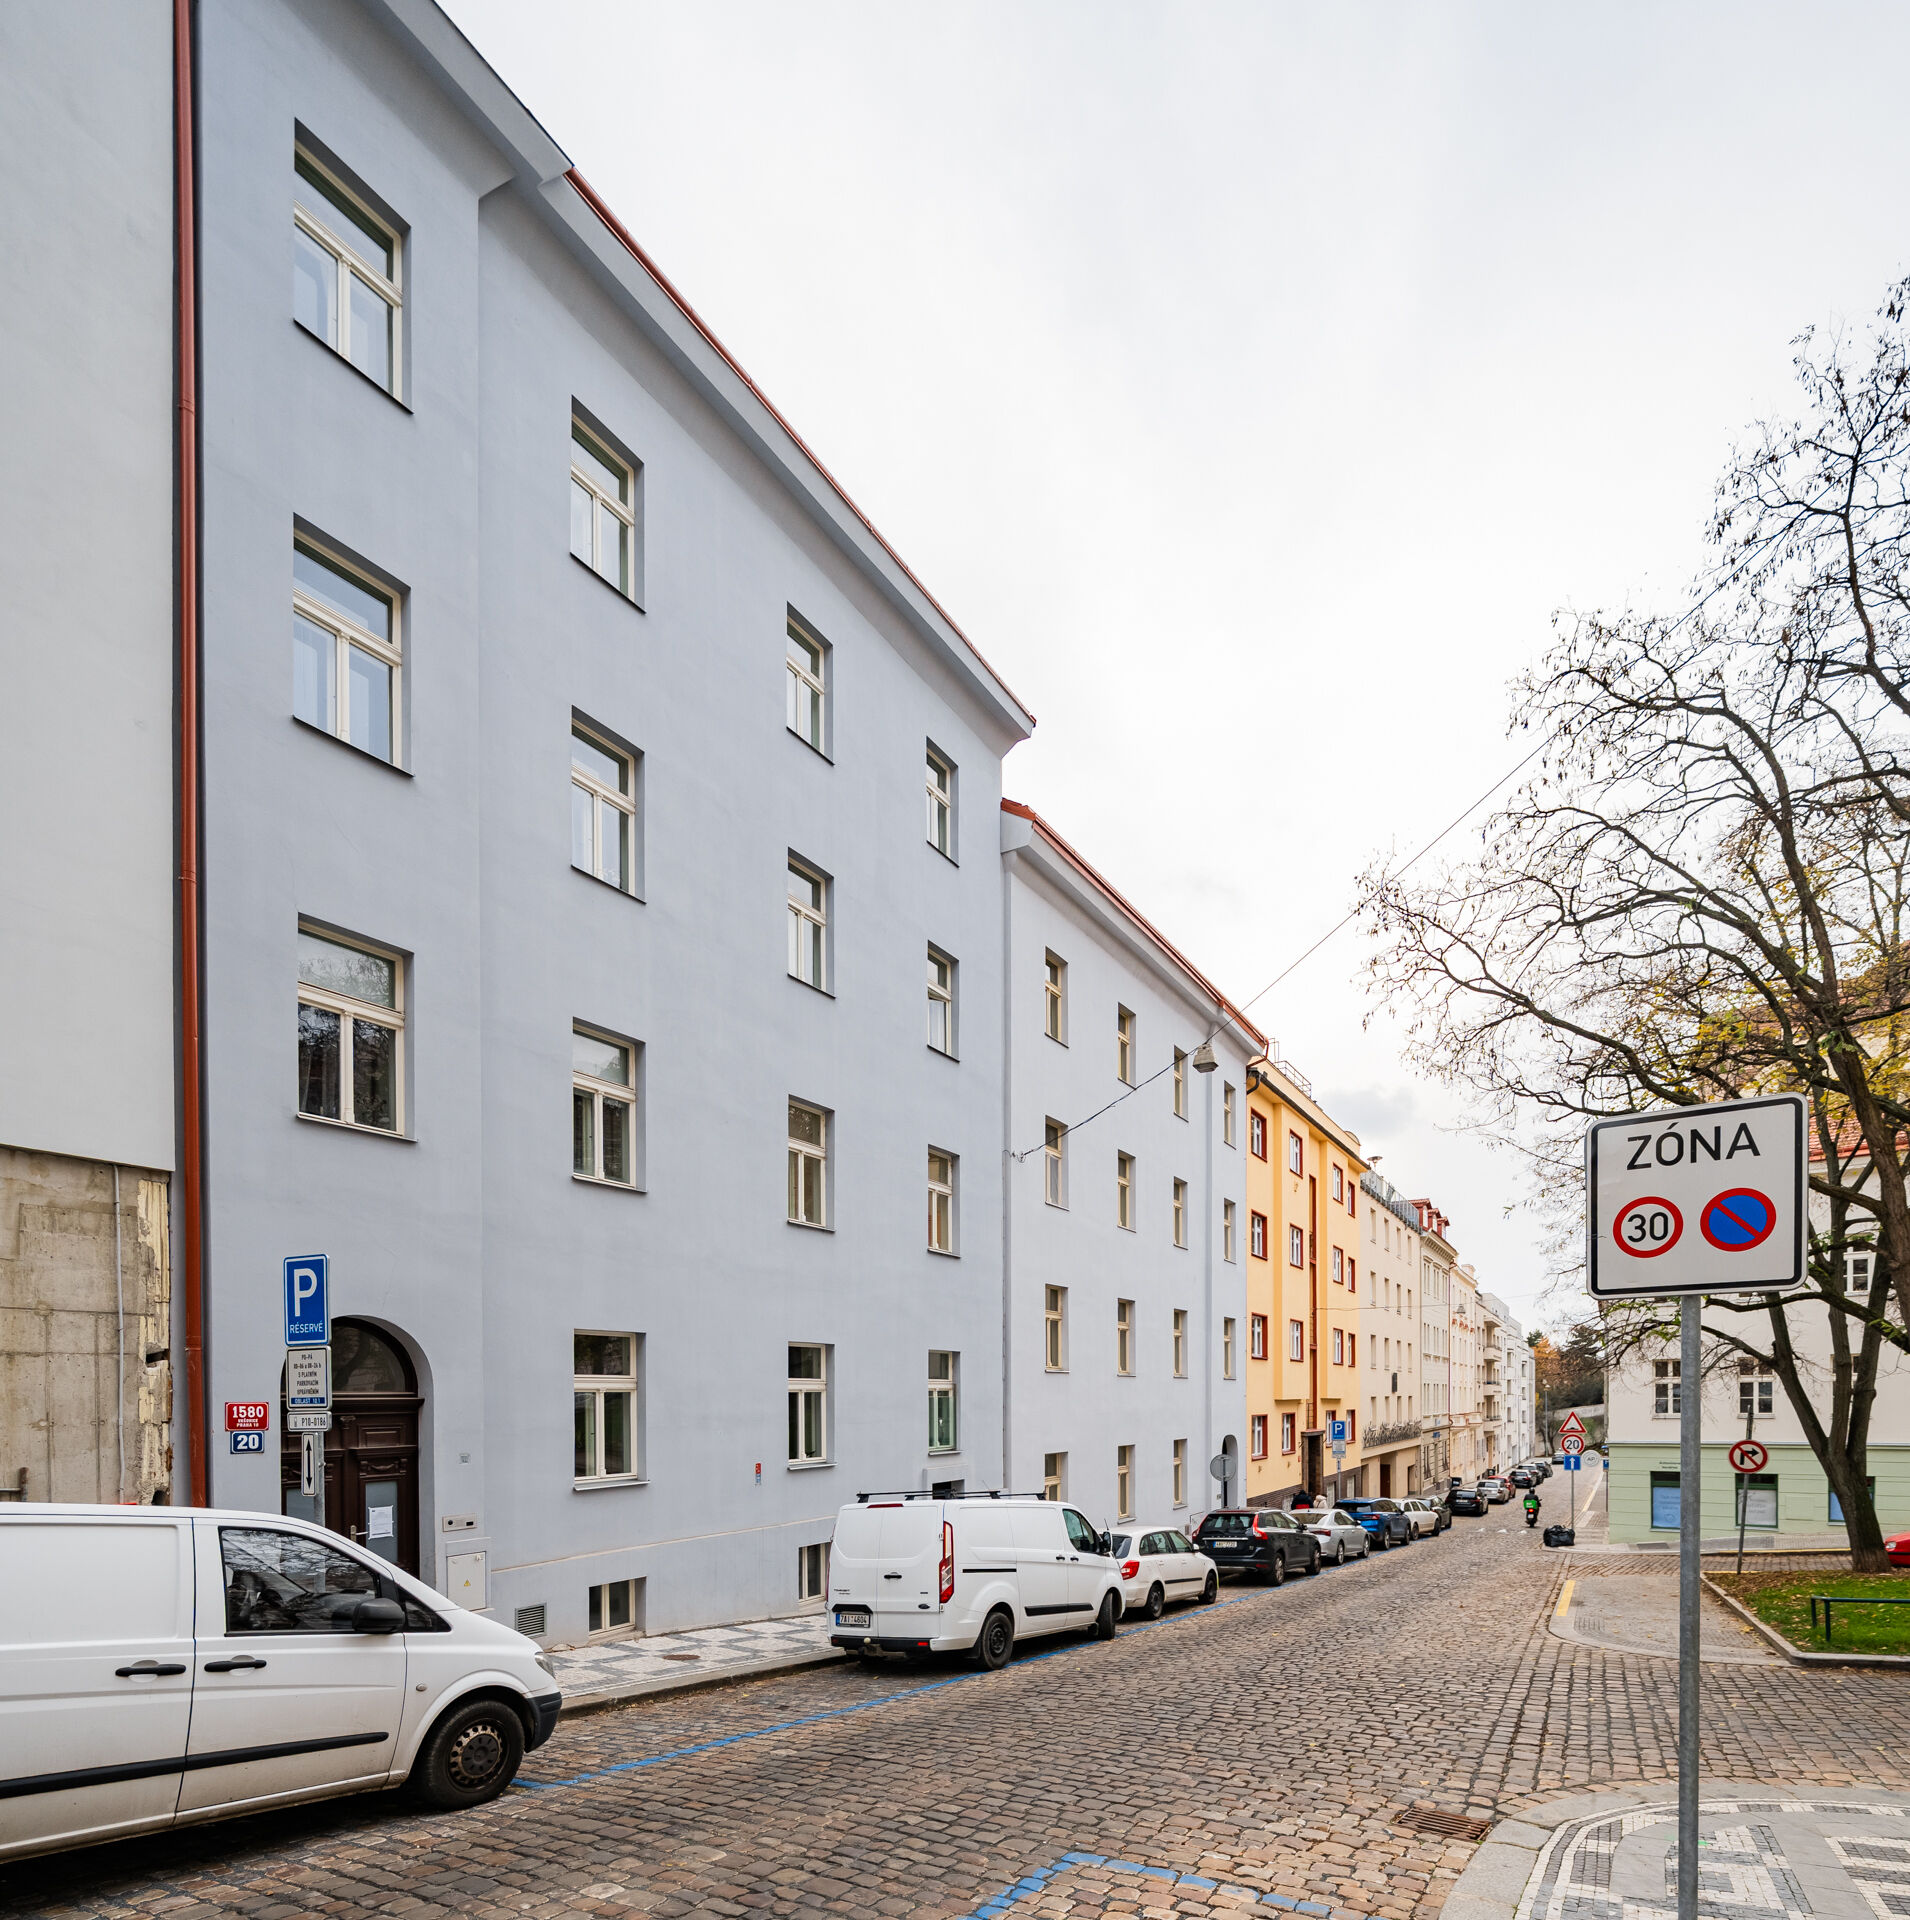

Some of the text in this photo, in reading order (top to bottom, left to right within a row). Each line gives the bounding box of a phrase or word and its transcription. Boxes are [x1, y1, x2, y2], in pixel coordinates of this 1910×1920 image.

[1627, 1121, 1761, 1170] ZÓNA
[1627, 1212, 1669, 1243] 30
[294, 1268, 318, 1317] P
[289, 1320, 324, 1334] RÉSERVÉ
[232, 1406, 264, 1418] 1580
[237, 1434, 259, 1450] 20
[1566, 1440, 1580, 1450] 20
